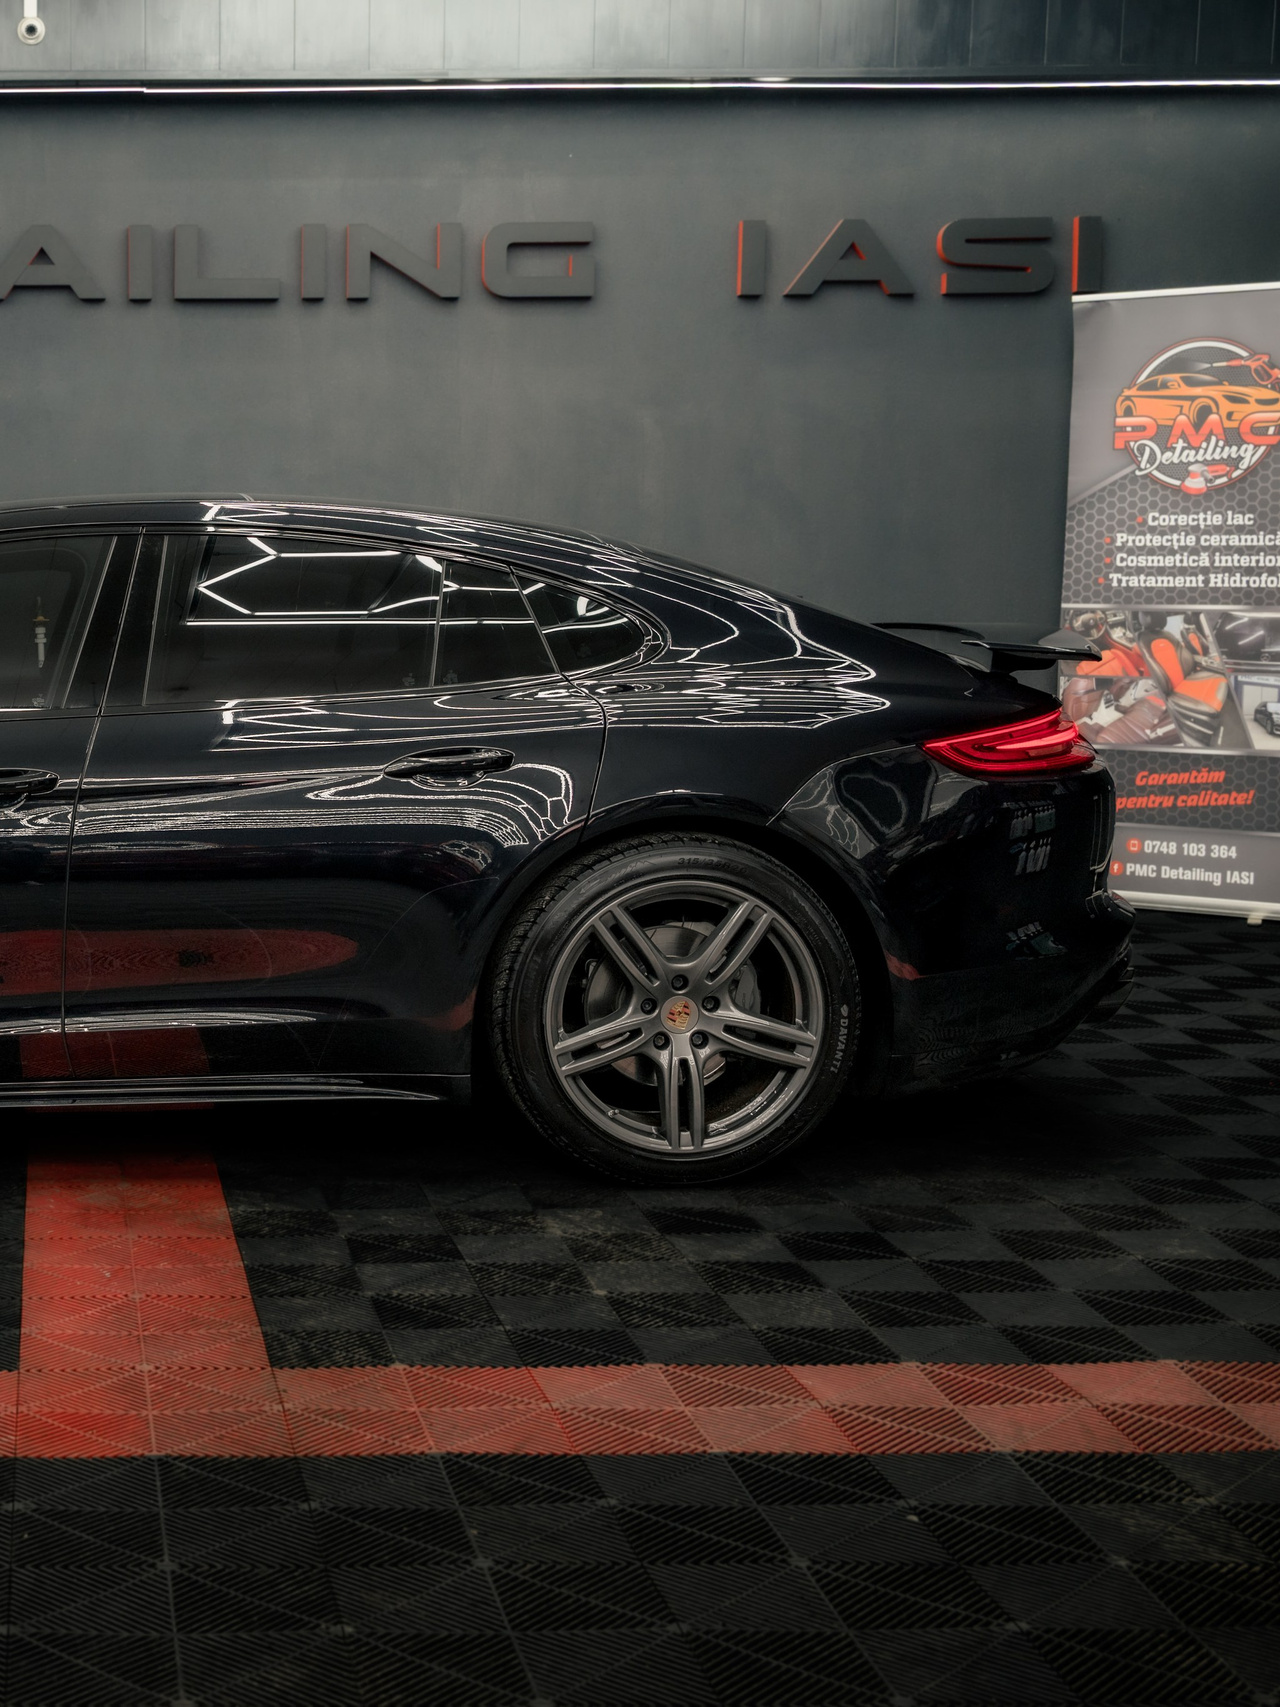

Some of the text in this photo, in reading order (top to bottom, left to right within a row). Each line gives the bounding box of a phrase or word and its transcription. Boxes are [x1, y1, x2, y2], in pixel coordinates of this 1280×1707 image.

[735, 216, 1104, 299] IASI
[1114, 411, 1280, 450] PMC
[1133, 435, 1257, 476] Detailing
[1226, 511, 1254, 525] lac
[1115, 552, 1210, 567] Cosmetică
[1109, 573, 1280, 588] Tratament Hidrofo
[1135, 767, 1226, 786] Garantăm
[1115, 790, 1256, 812] pentru calitate!
[1143, 840, 1237, 859] 0748 103 364
[1126, 863, 1255, 886] PMC Detailing IASI
[830, 1018, 849, 1074] DAVANTI
